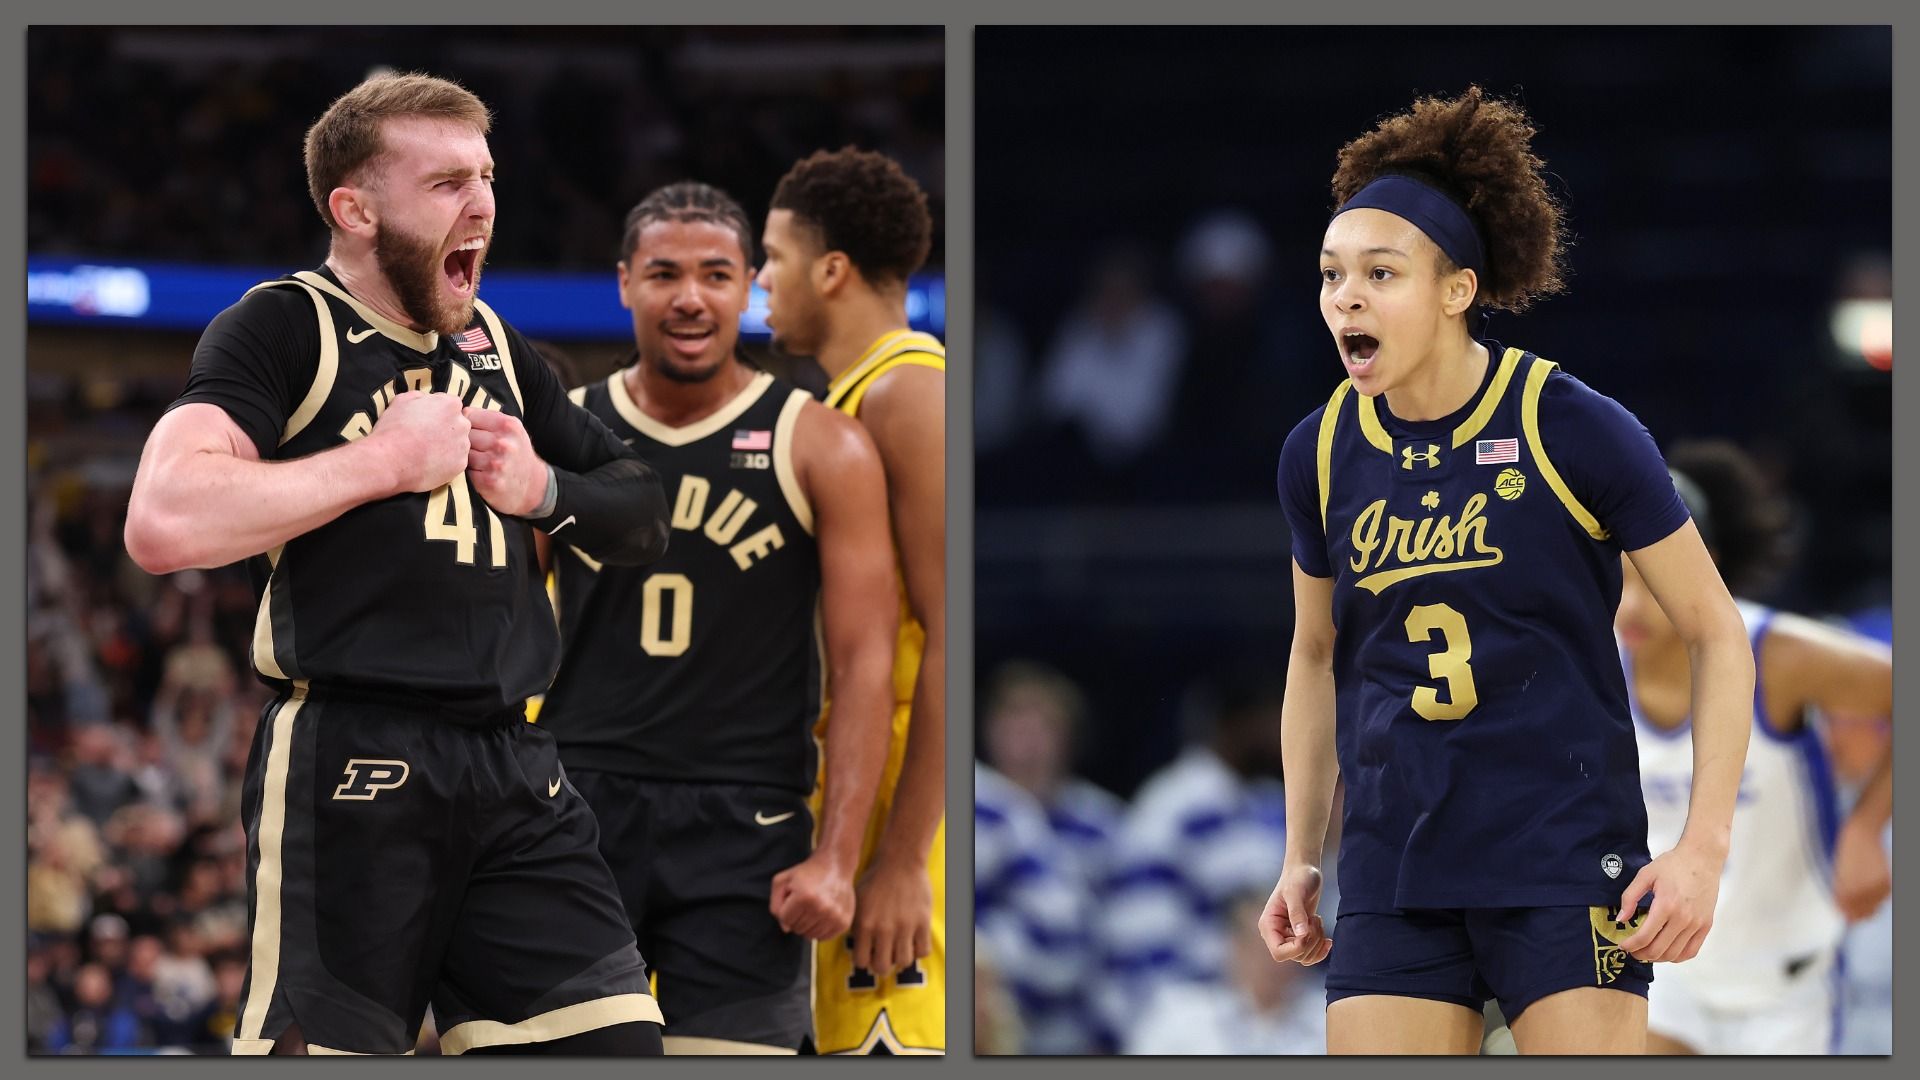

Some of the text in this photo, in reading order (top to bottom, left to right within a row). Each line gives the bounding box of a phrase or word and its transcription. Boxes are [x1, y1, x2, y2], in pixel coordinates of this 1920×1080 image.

[425, 471, 507, 567] 41
[671, 474, 785, 571] DUE
[1498, 477, 1524, 488] ACC
[1350, 492, 1503, 596] Irish
[641, 573, 693, 656] 0
[1404, 602, 1478, 721] 3
[332, 759, 409, 800] P
